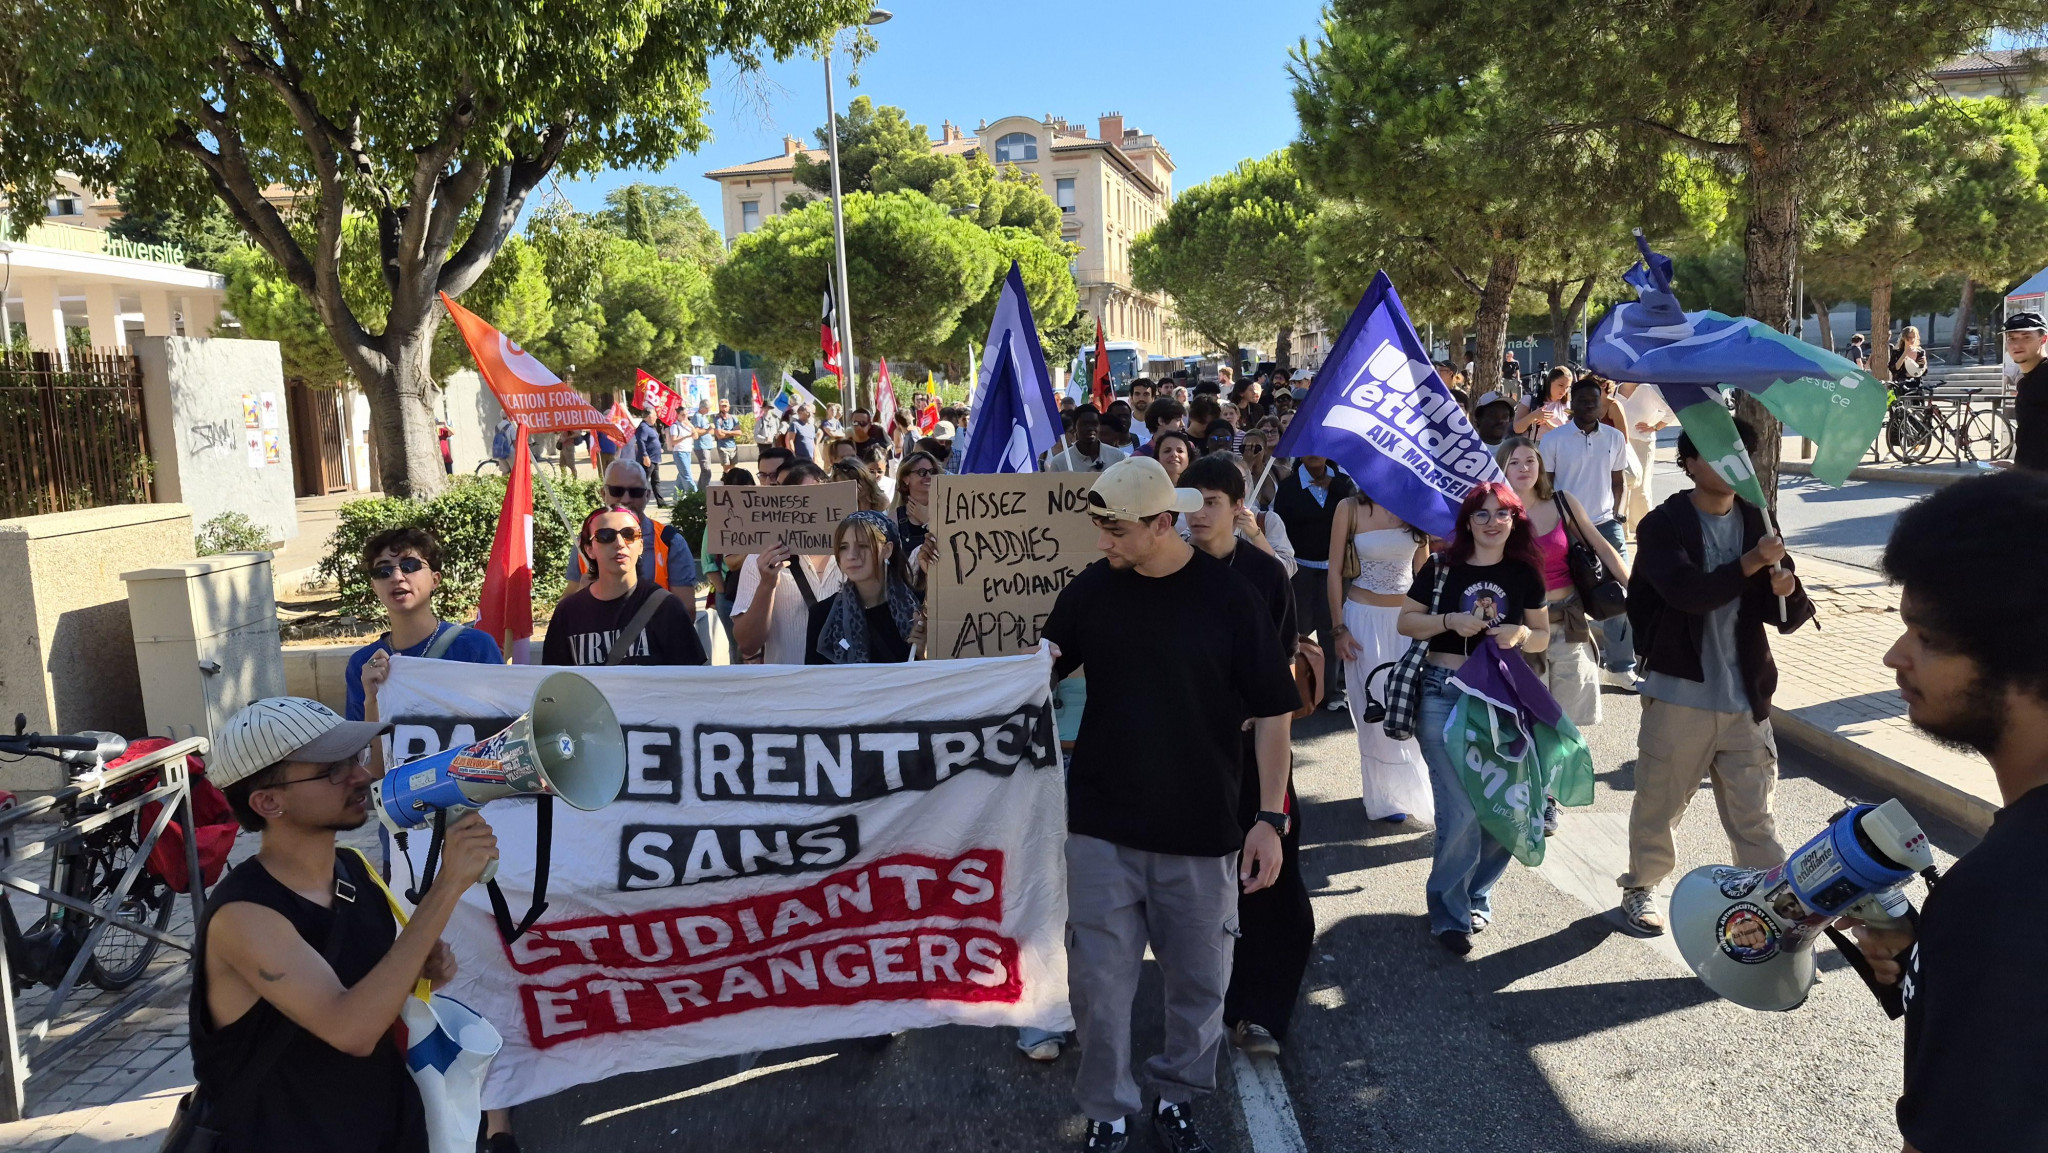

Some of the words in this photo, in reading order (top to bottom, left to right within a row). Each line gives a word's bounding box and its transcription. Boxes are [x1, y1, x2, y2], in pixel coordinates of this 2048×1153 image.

[101, 231, 185, 266] Université
[713, 490, 734, 508] LA
[751, 510, 818, 525] EMMERDE
[826, 506, 843, 522] LE
[1048, 482, 1089, 515] NOS
[720, 529, 770, 547] FRONT
[778, 528, 833, 549] NATIONAL
[949, 526, 1060, 585] BADDIES
[1463, 582, 1483, 597] BOSS
[951, 610, 1049, 659] APPRE
[627, 730, 674, 795] E
[625, 825, 847, 888] SANS
[510, 858, 995, 966] ETUDIANTS
[533, 934, 1008, 1038] ETRANGERS
